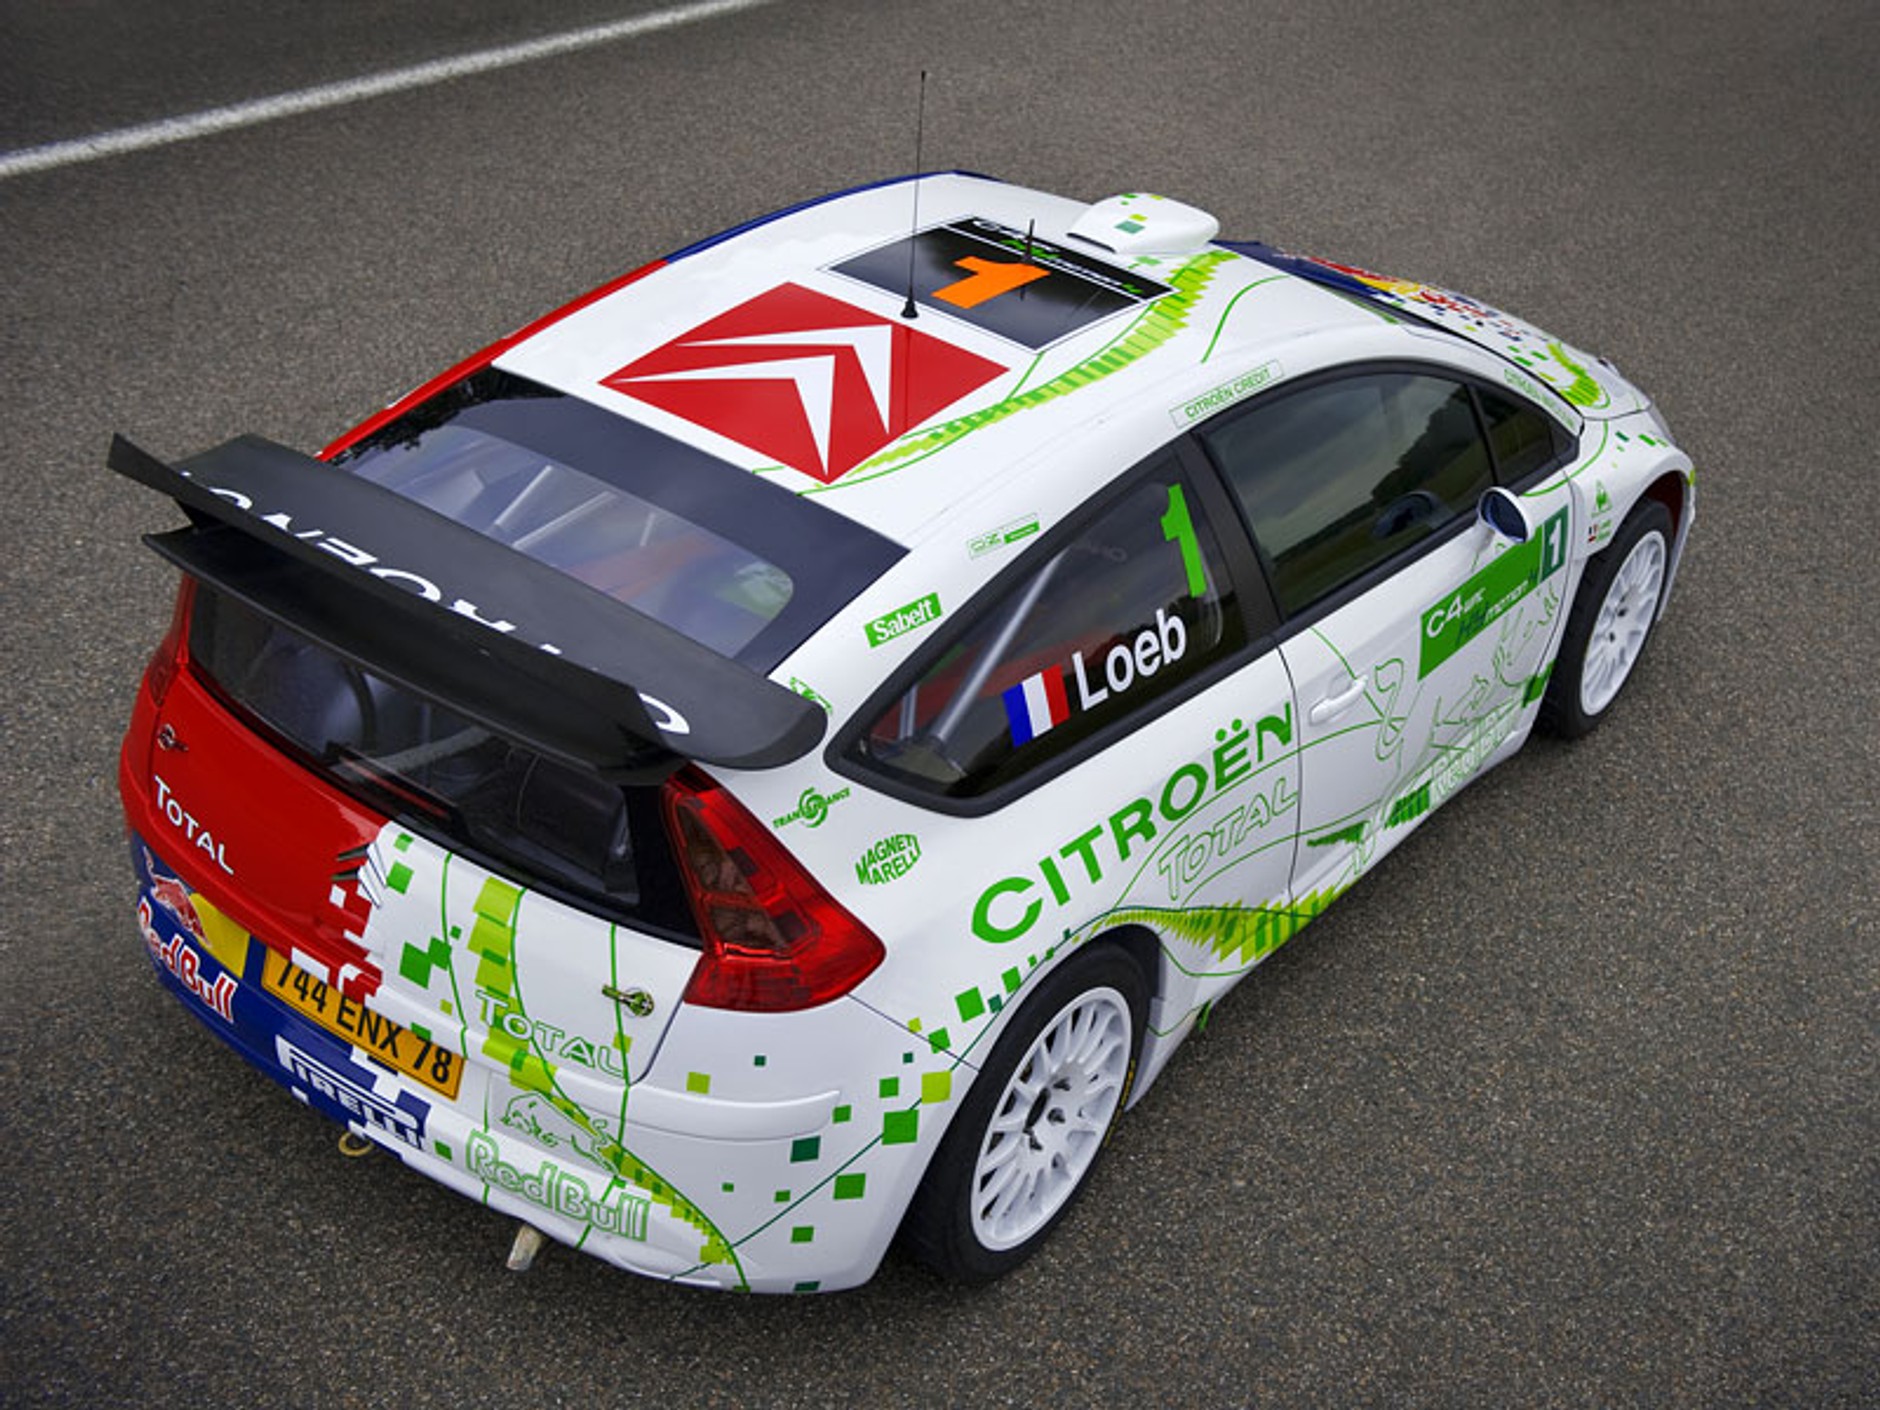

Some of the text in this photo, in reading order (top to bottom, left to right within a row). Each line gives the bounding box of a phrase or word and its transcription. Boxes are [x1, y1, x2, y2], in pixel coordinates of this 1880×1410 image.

[931, 256, 1052, 309] 1
[1160, 483, 1207, 598] 1
[1547, 515, 1565, 563] 1
[873, 600, 935, 641] Sabelt
[1071, 608, 1187, 712] Loeb
[155, 775, 234, 876] TOTAL
[971, 702, 1293, 944] CITROËN
[1158, 777, 1300, 902] TOTAL
[277, 962, 453, 1084] 744 ENX 78
[475, 989, 629, 1079] TOTAL
[275, 1034, 421, 1150] PIRELLI
